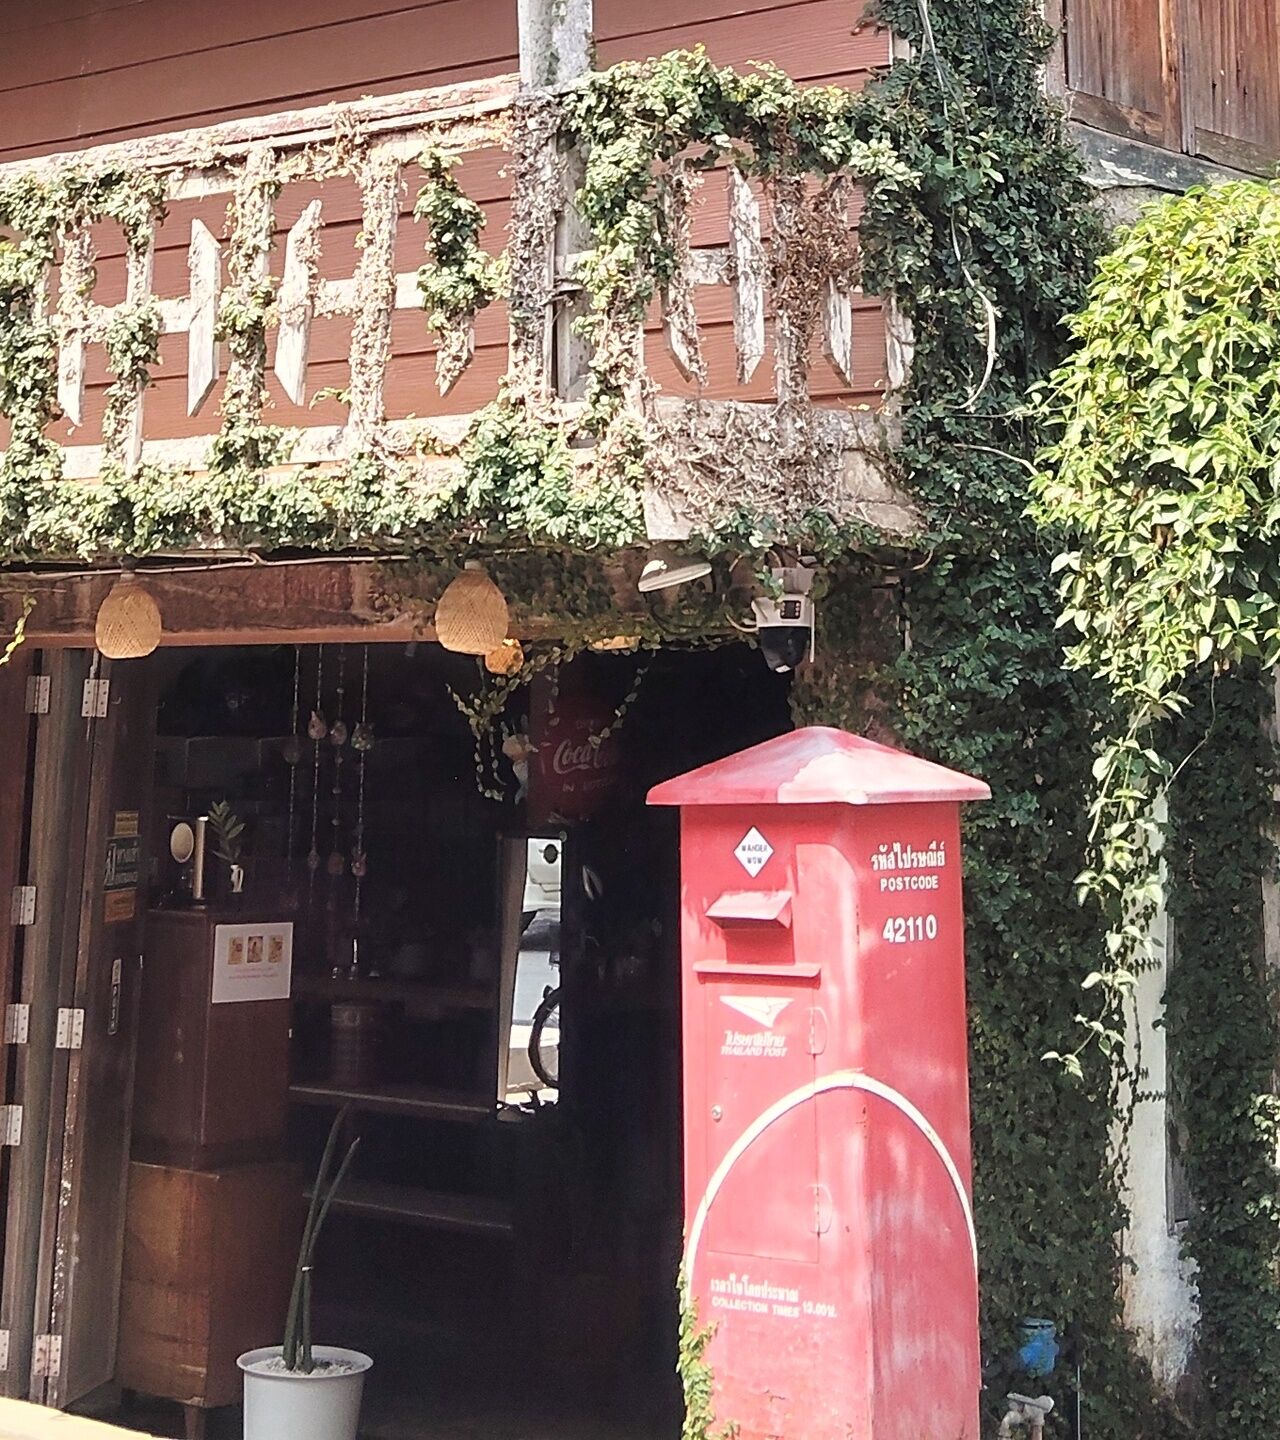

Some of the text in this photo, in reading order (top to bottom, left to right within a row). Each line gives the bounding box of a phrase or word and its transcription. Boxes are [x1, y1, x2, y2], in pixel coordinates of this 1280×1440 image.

[870, 841, 946, 872] รหัสไปรษณีย์
[880, 875, 939, 892] POSTCODE
[882, 914, 938, 943] 42110
[720, 1045, 788, 1057] THAILAND POST
[711, 1295, 769, 1314] COLLECTION
[771, 1304, 800, 1318] TIMES
